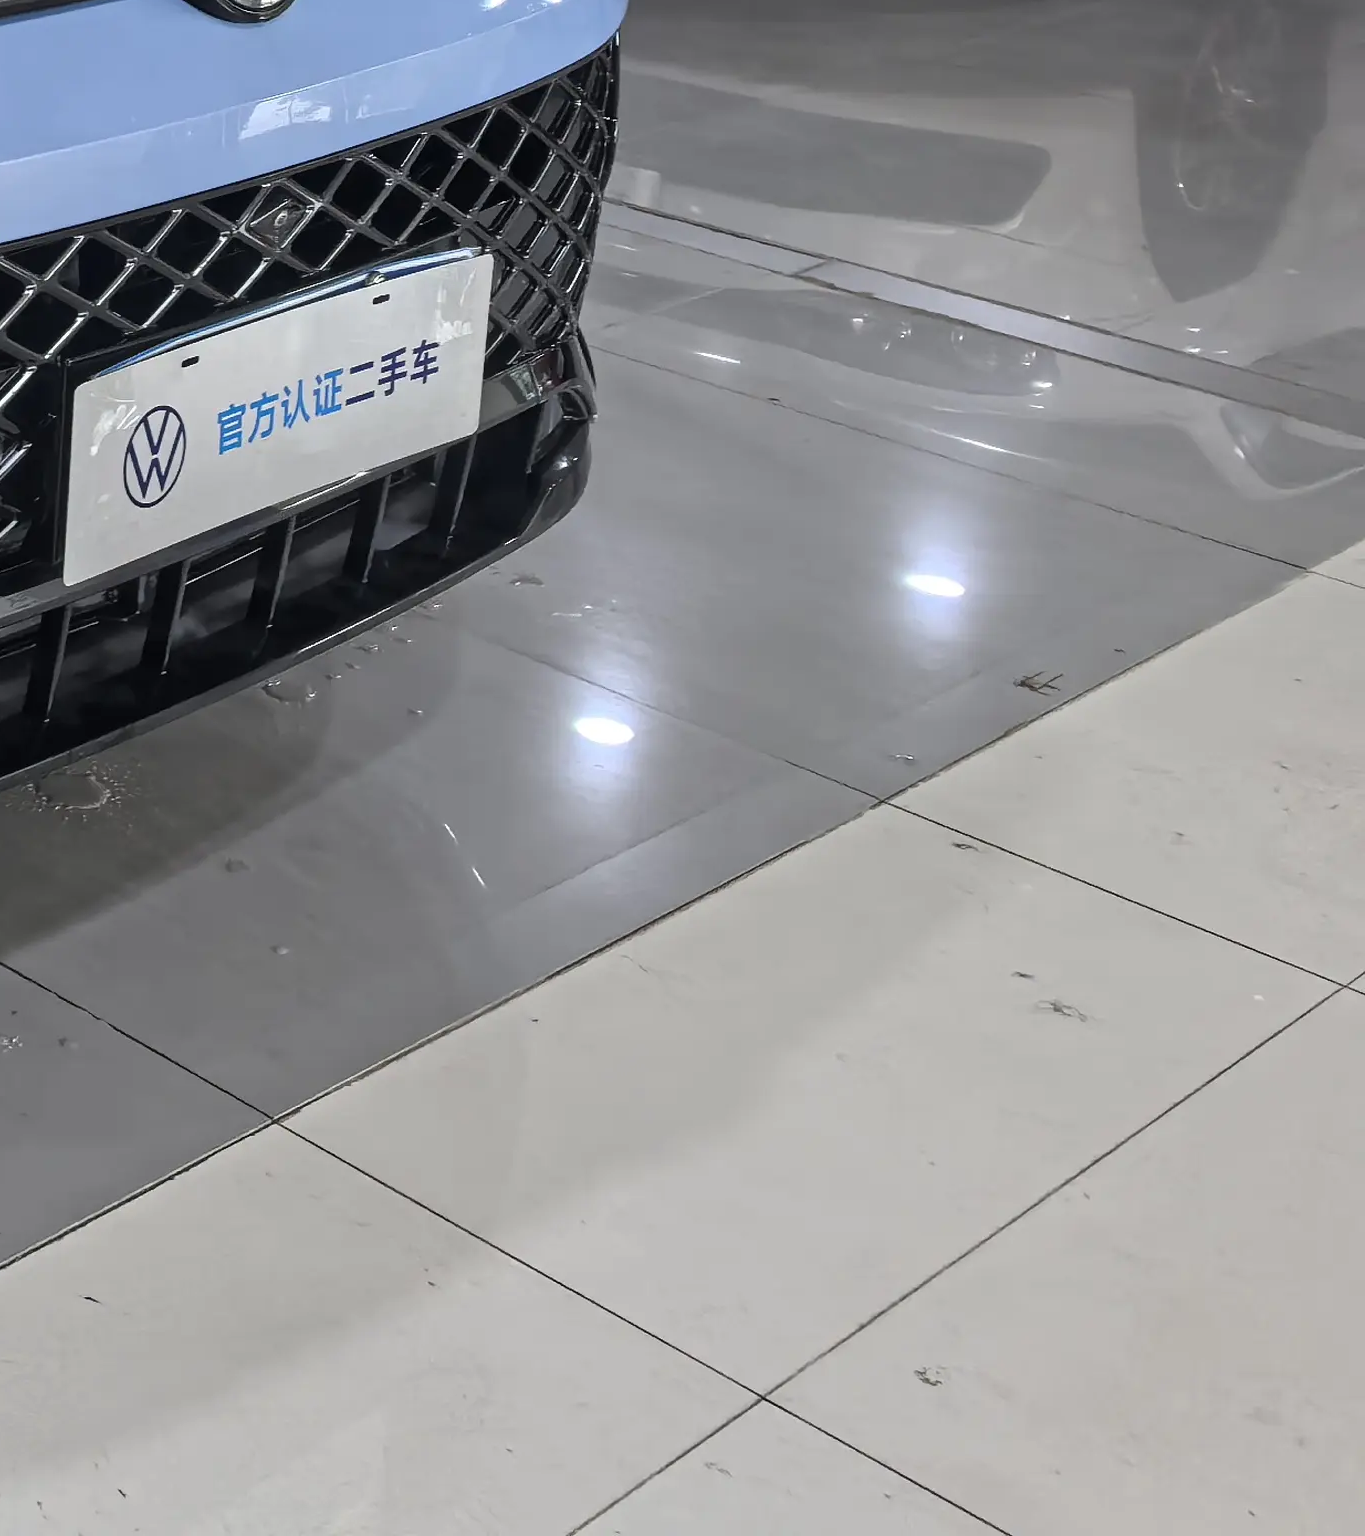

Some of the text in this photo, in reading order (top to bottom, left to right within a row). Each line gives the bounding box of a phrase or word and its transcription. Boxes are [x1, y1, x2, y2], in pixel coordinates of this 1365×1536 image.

[217, 339, 440, 455] 官方认证二手车
[123, 406, 187, 508] VW
